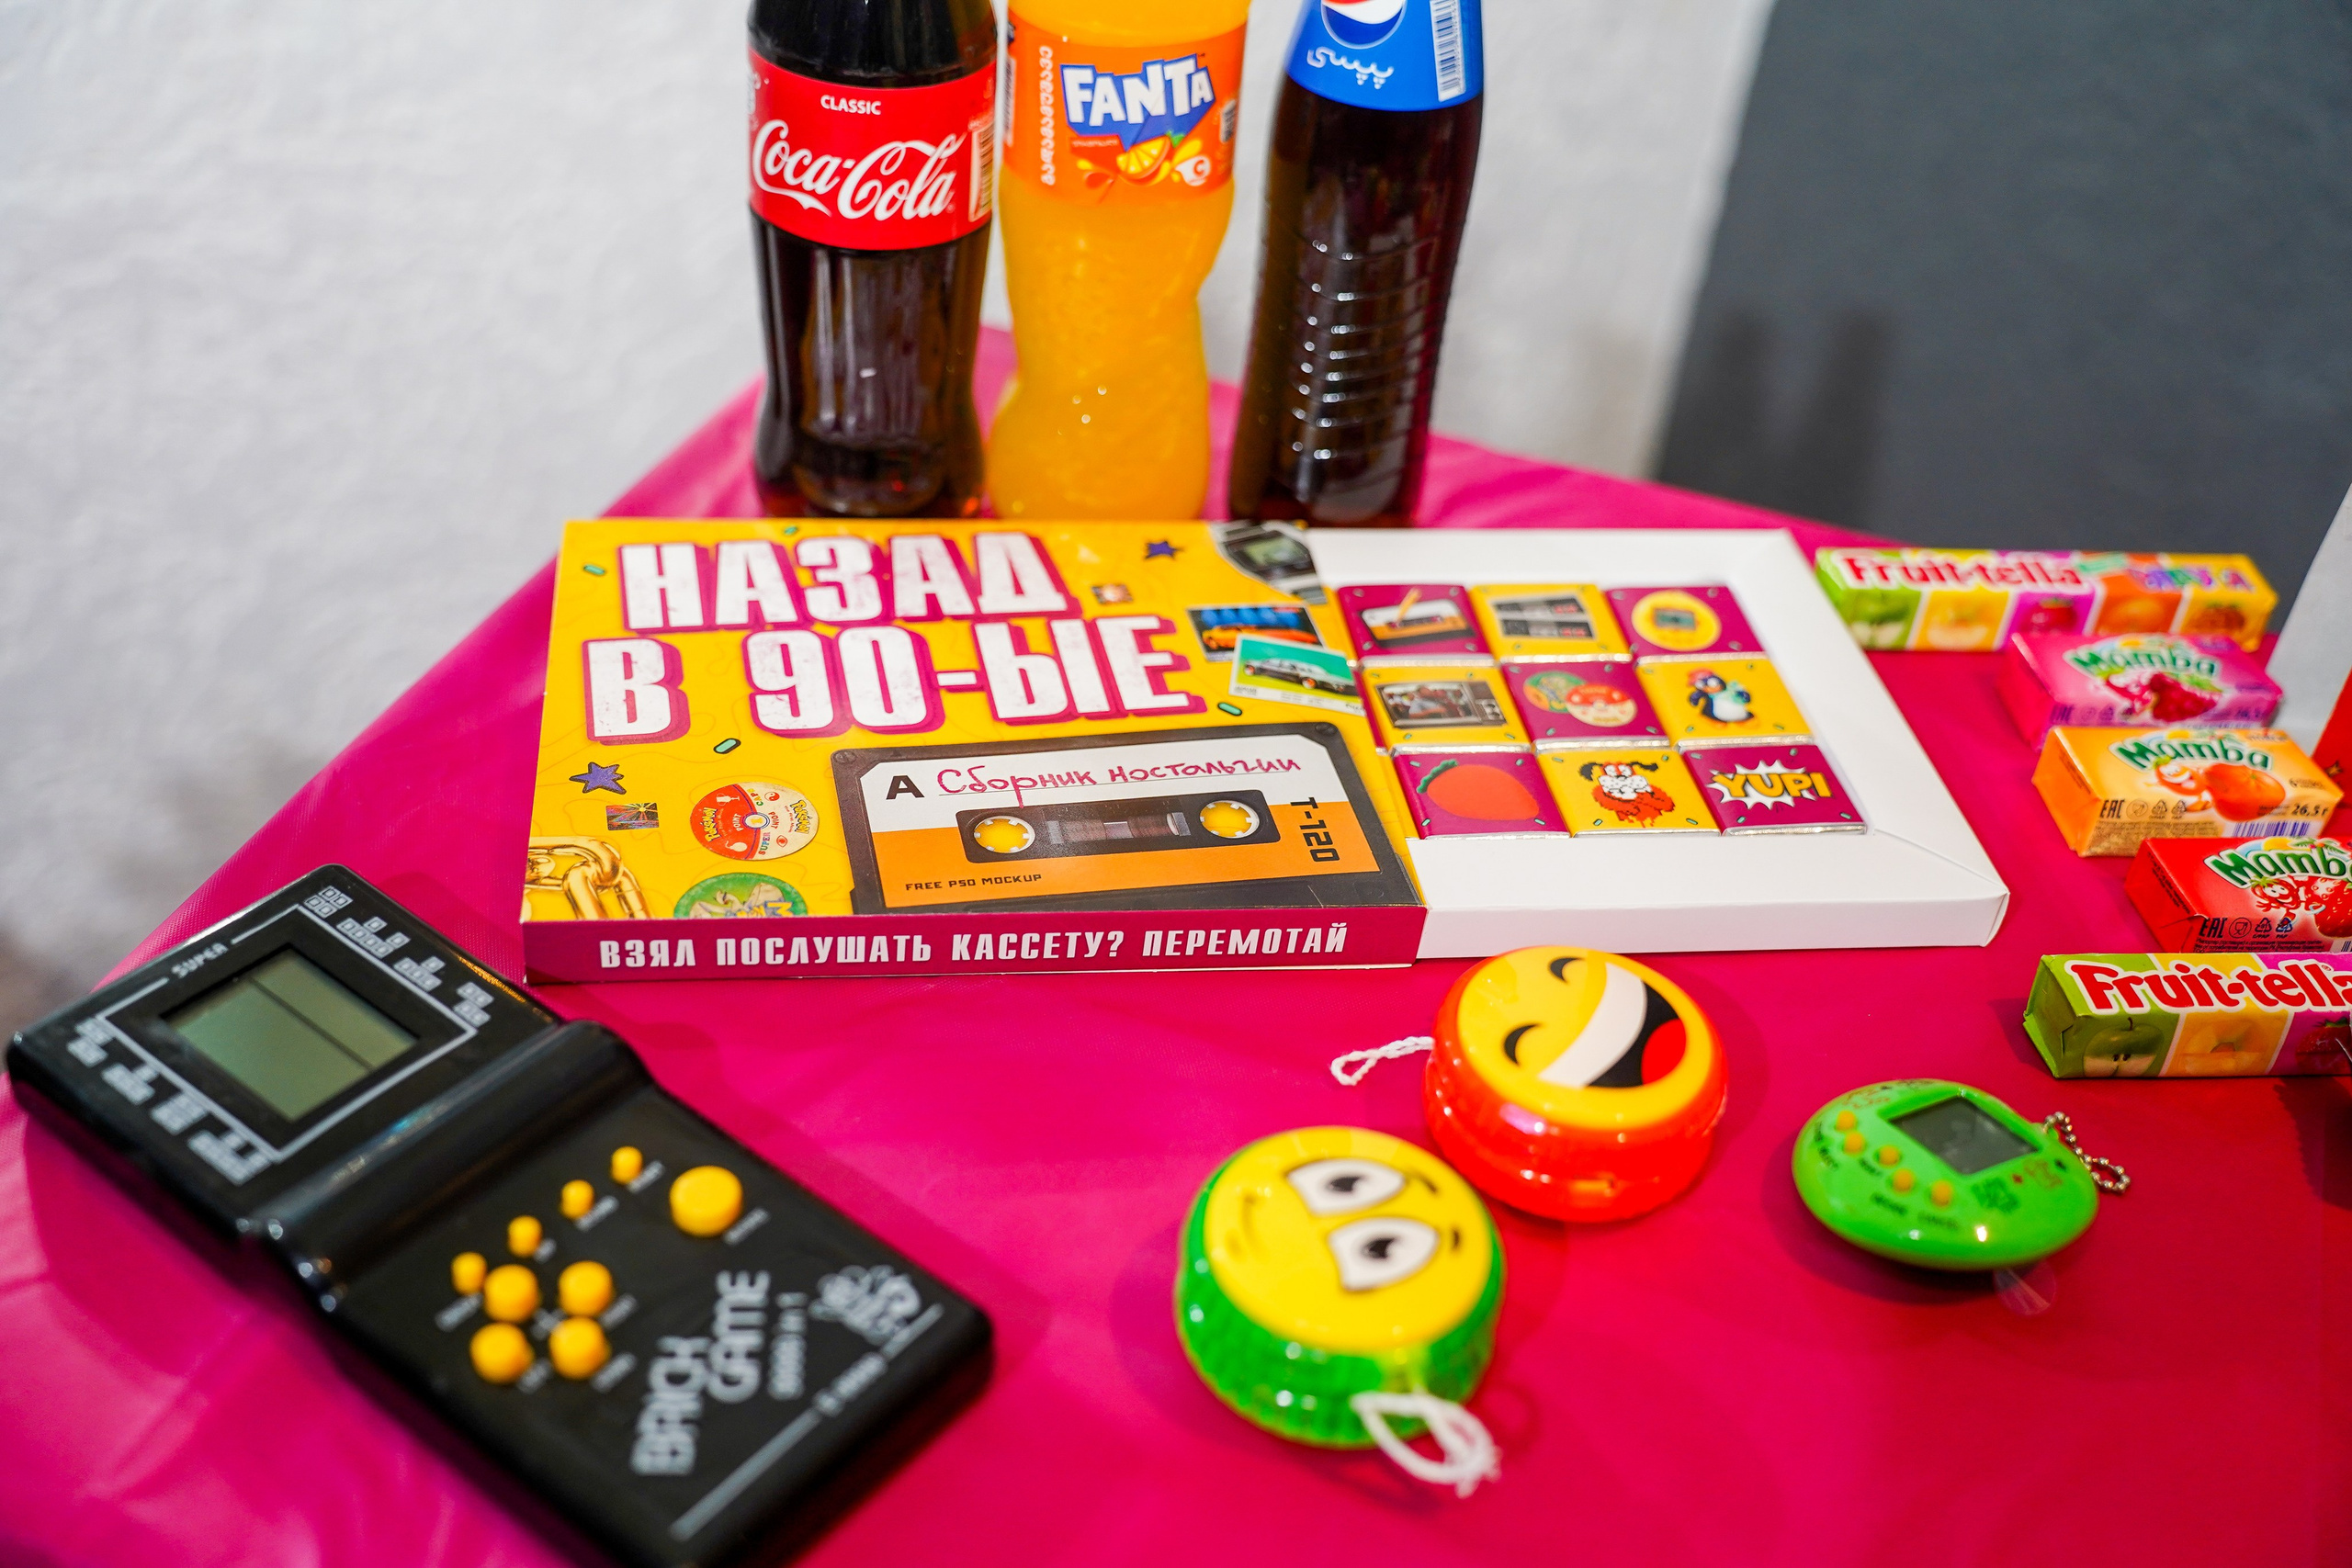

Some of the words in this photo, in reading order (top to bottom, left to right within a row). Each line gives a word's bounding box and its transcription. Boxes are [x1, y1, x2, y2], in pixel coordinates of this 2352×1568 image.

[820, 95, 881, 116] CLASSIC
[1062, 57, 1215, 127] FANTA
[752, 118, 965, 221] Coca-Cola
[619, 531, 1079, 631] НАЗАД
[1841, 555, 2083, 589] Fruit-tella
[584, 637, 687, 743] В
[743, 616, 1204, 737] 90-ЫЕ
[2071, 646, 2219, 679] Mamba
[2117, 738, 2270, 770] Mamba
[747, 788, 763, 807] CAPS
[886, 775, 925, 800] A
[937, 765, 1098, 808] Сборник
[1109, 758, 1301, 783] ностальгии
[1713, 772, 1833, 798] YUPI
[732, 813, 743, 831] POINT
[768, 811, 779, 829] POINT
[1290, 797, 1340, 862] T-120
[758, 832, 771, 855] SUPER
[905, 881, 943, 891] FREE
[949, 878, 976, 887] PSD
[982, 874, 1042, 886] MOCKUP
[2211, 848, 2352, 886] Mamb
[600, 939, 696, 969] ВЗЯЛ
[717, 934, 932, 966] ПОСЛУШАТЬ
[952, 931, 1125, 961] КАССЕТУ?
[1142, 922, 1348, 957] ПЕРЕМОТАЙ
[705, 1269, 771, 1404] GAME
[630, 1335, 712, 1476] BRICK
